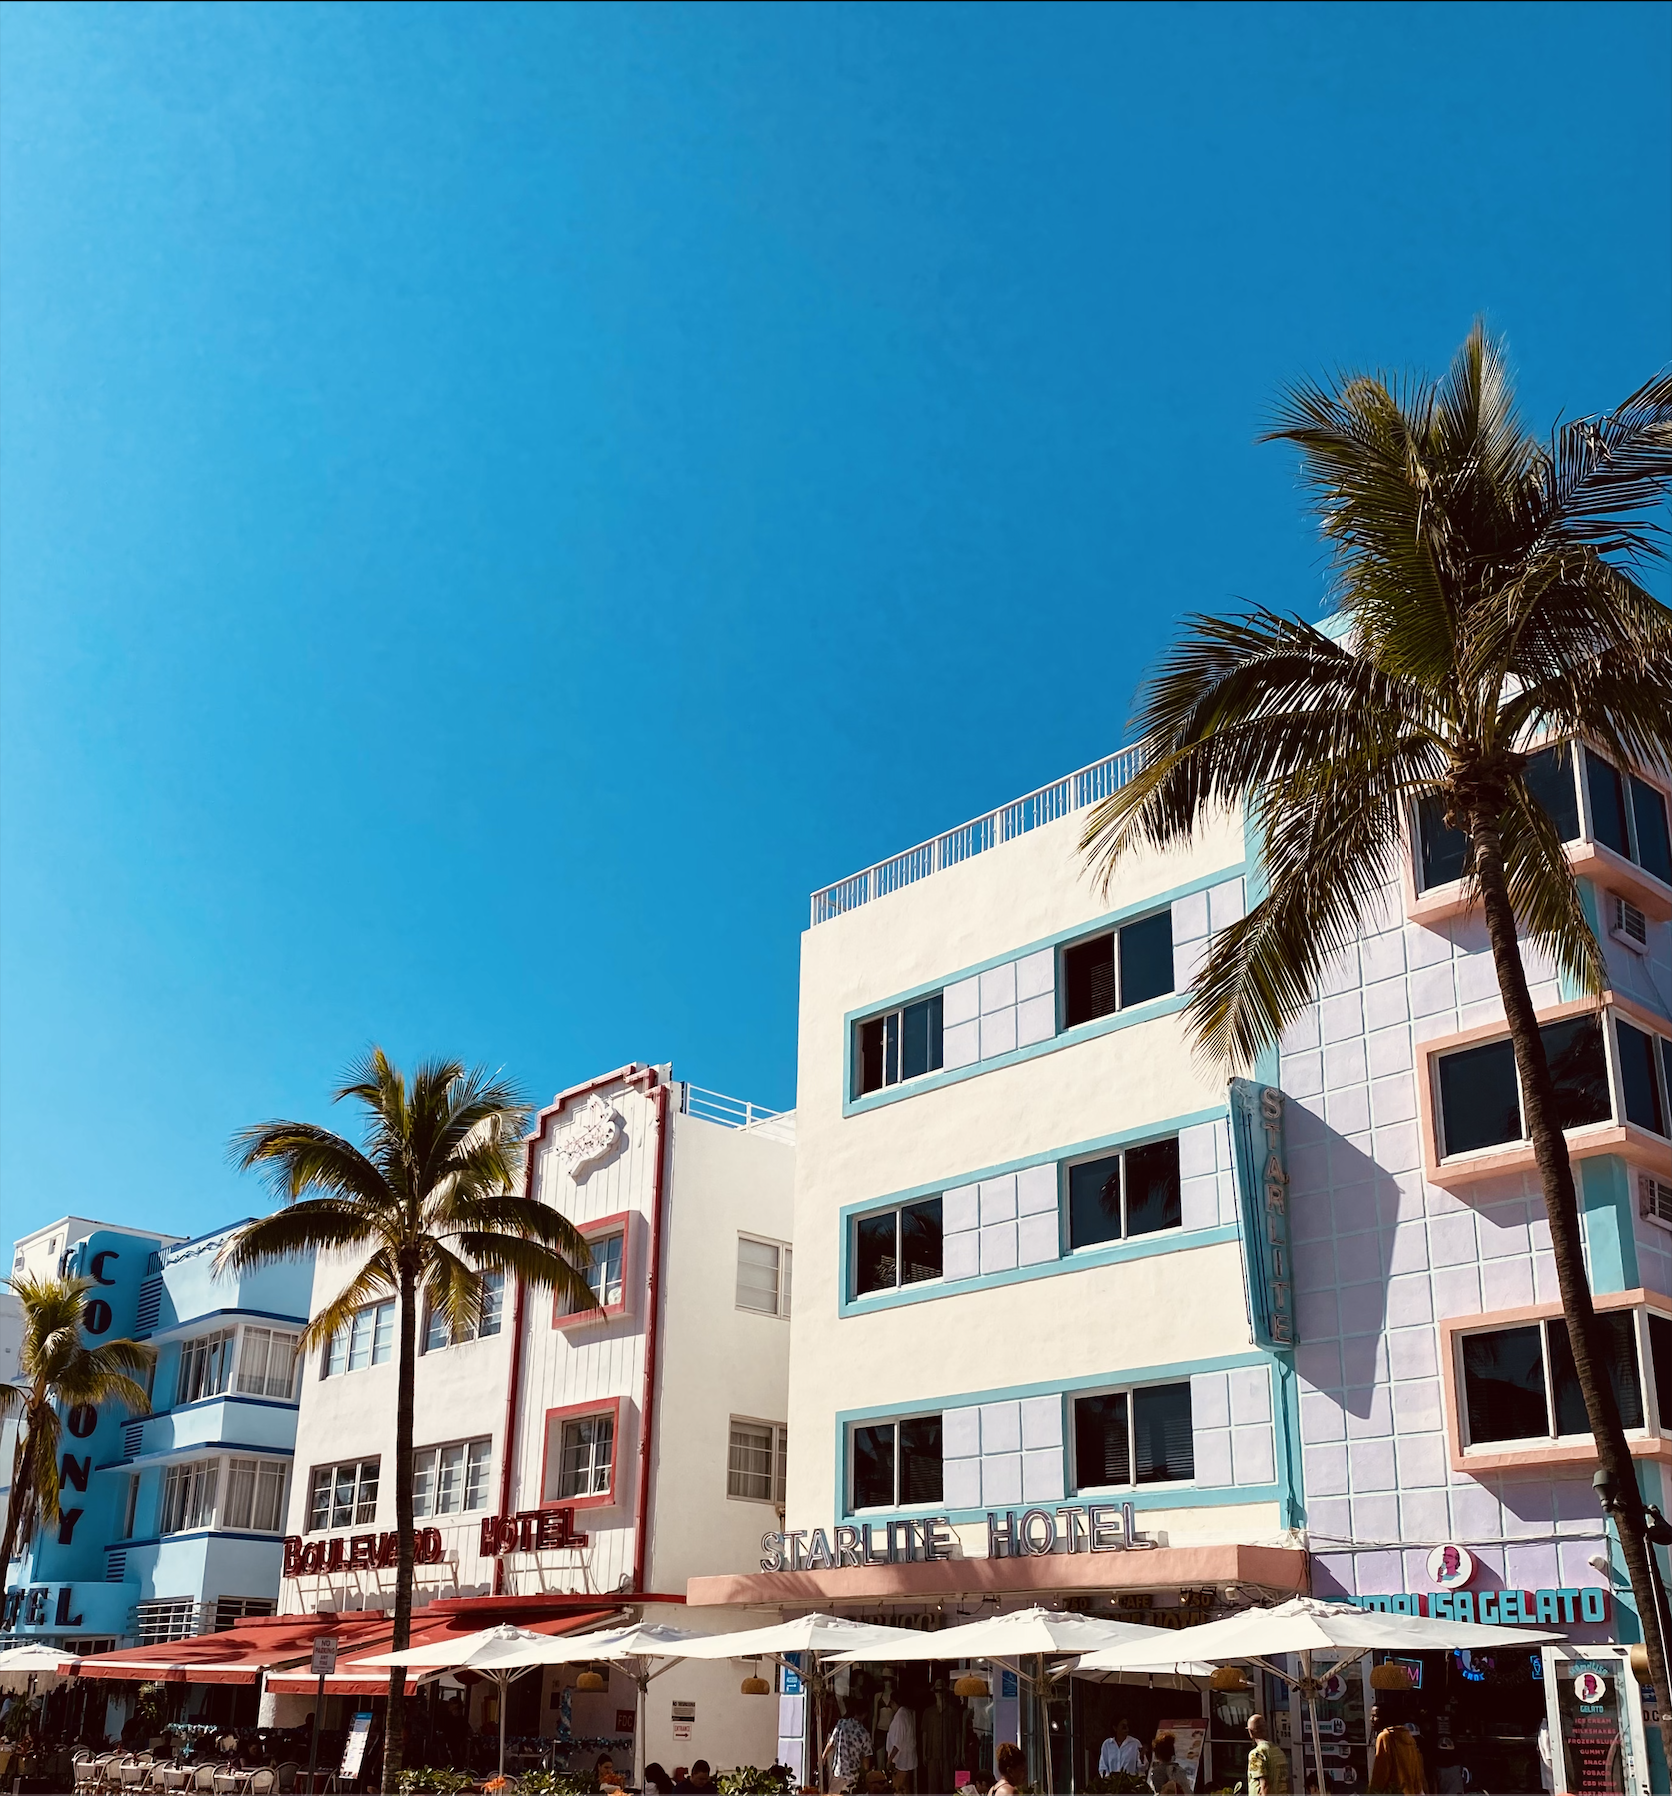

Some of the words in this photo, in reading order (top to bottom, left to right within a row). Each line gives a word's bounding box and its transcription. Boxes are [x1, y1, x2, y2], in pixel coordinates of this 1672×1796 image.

[1260, 1088, 1291, 1344] STARLITE
[58, 1251, 119, 1545] COONY
[480, 1507, 588, 1557] HOTEL
[760, 1516, 950, 1572] STARLITE
[987, 1502, 1158, 1559] HOTEL
[1119, 1594, 1150, 1609] CAFE
[1319, 1590, 1474, 1623] MALISA
[1479, 1587, 1605, 1624] GELATO
[618, 1715, 633, 1727] FDC
[1580, 1705, 1604, 1713] GELATO
